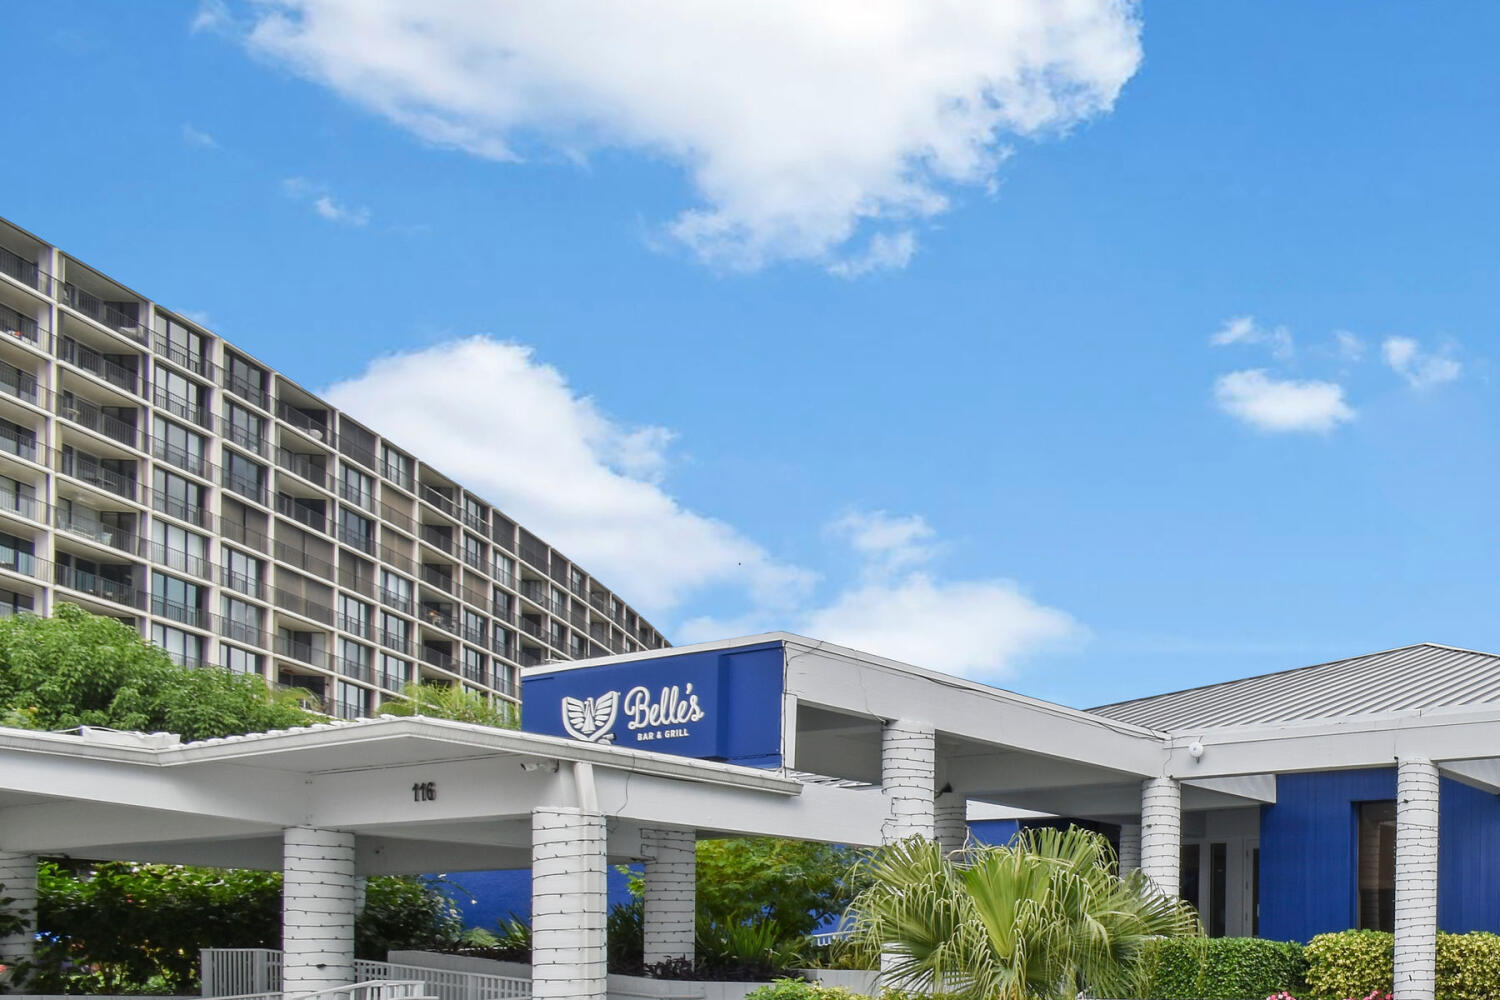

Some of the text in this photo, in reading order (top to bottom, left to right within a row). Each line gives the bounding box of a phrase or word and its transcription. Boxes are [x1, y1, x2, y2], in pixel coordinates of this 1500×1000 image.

[624, 682, 705, 730] Belle's
[637, 728, 690, 741] BAR & GRILL
[411, 781, 437, 802] 116
